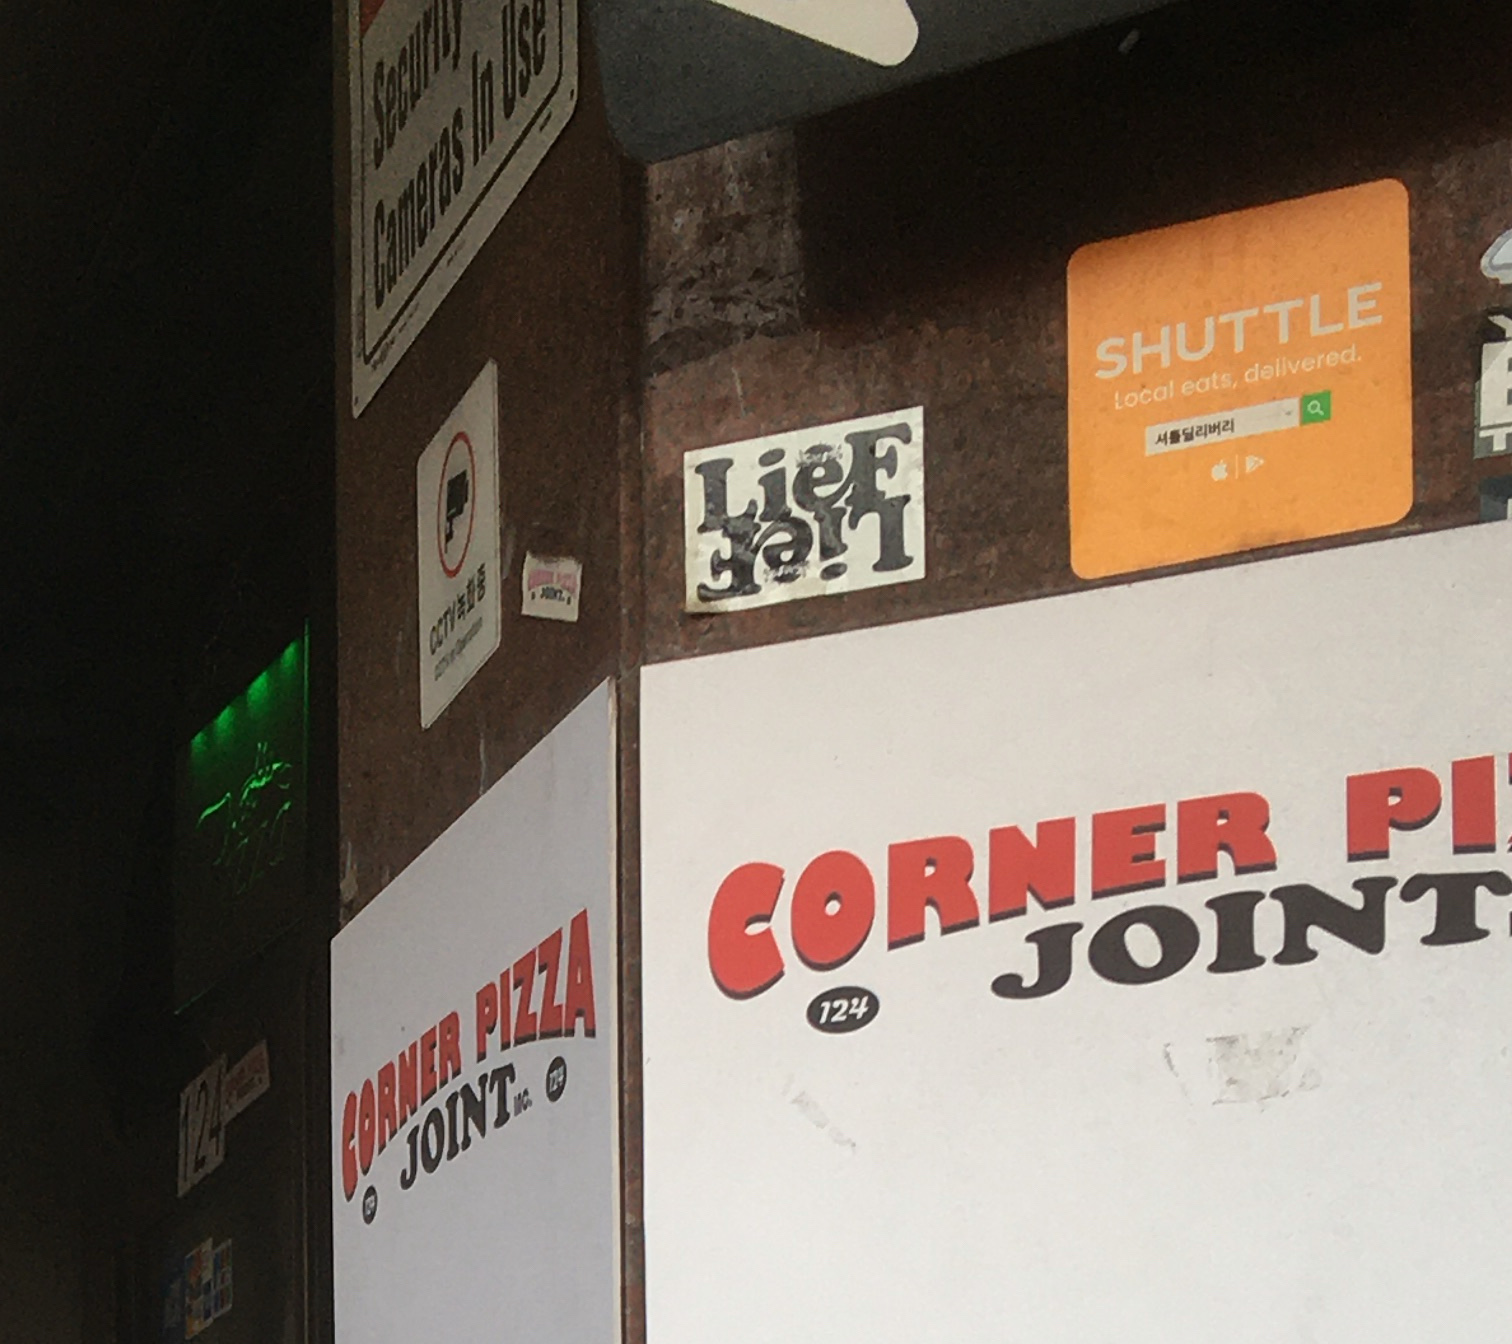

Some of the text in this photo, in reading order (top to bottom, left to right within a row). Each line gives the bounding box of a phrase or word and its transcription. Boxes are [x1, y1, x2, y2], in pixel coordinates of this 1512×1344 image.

[372, 0, 464, 171] Security
[372, 0, 547, 310] Cameras In Use
[1094, 281, 1383, 380] SHUTTLE
[1114, 343, 1363, 411] Local eats, delivered.
[707, 754, 1512, 1000] CORNER PI
[990, 870, 1512, 999] JOINT
[341, 907, 597, 1203] CORNER PIZZA
[817, 993, 870, 1024] 124
[400, 1062, 517, 1191] JOINT
